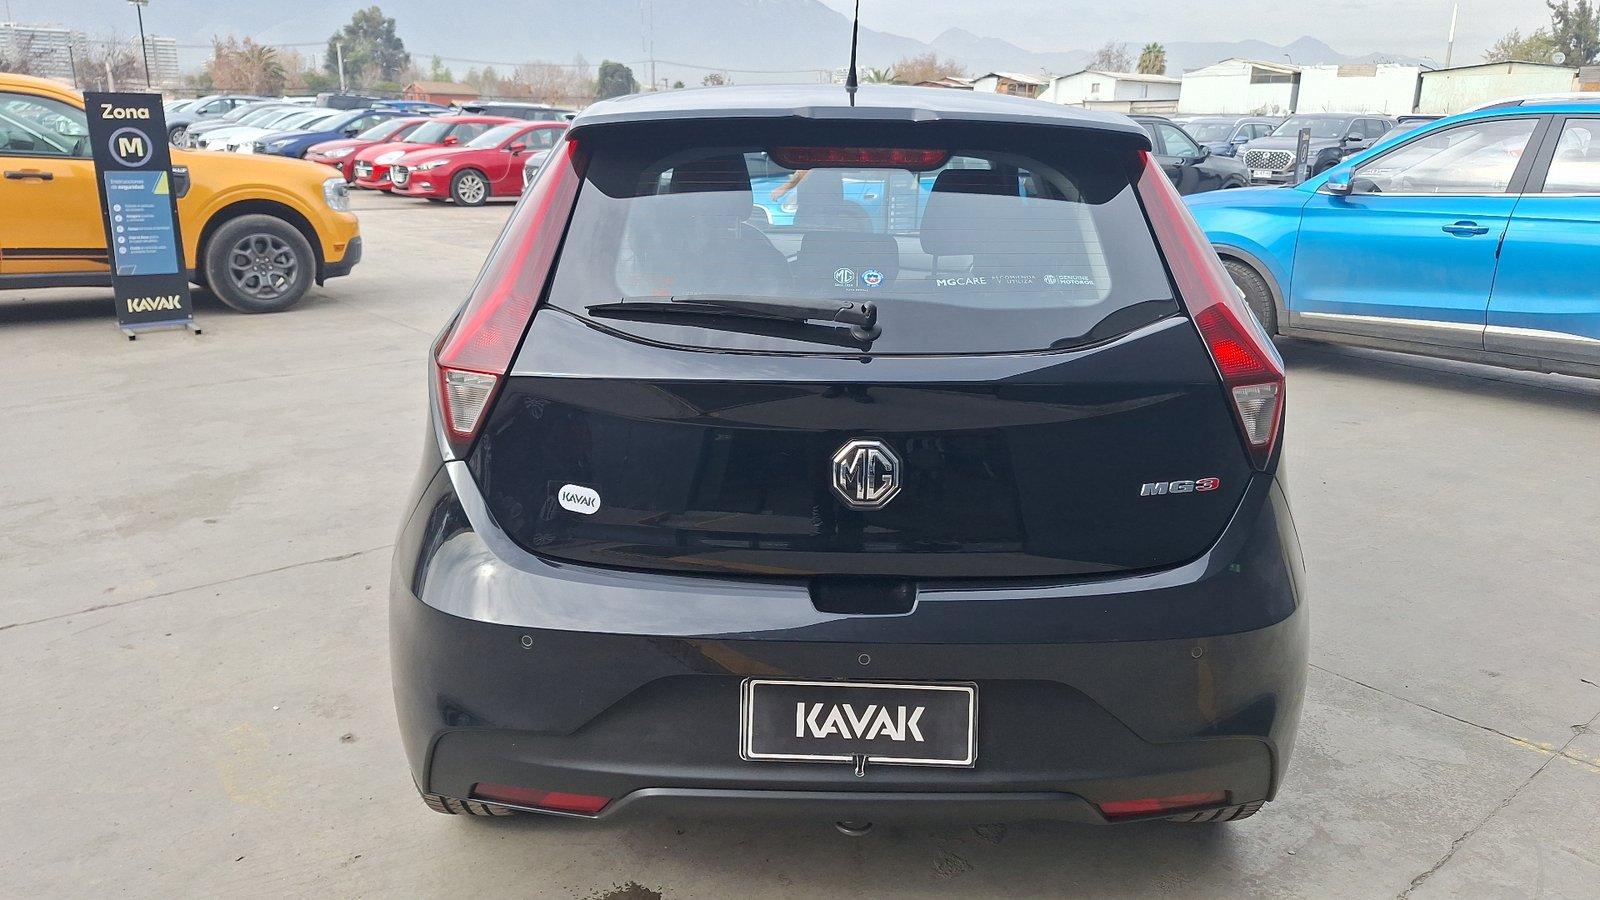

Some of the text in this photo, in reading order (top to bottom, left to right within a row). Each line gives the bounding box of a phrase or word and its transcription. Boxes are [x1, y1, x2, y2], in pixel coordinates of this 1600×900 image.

[100, 103, 149, 119] Zona
[118, 137, 144, 157] M
[835, 269, 853, 283] MG
[127, 294, 182, 313] KAVAK
[840, 448, 893, 500] MG
[1140, 477, 1220, 497] MG3
[562, 491, 596, 508] KAVAK
[795, 702, 926, 742] KAVAK
